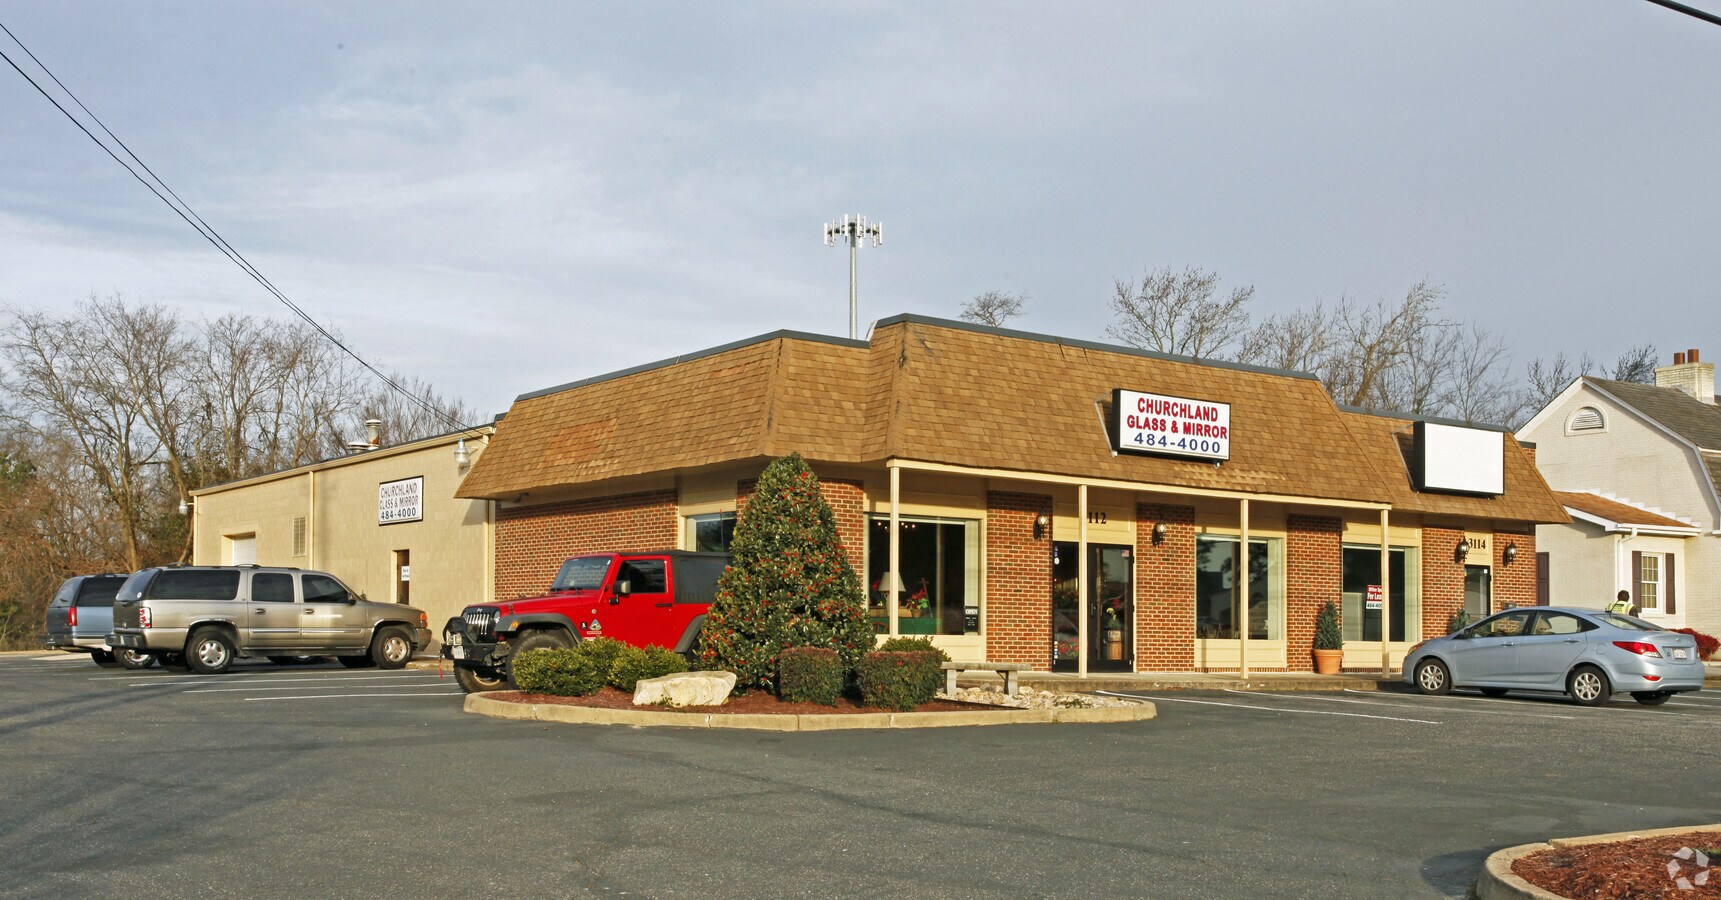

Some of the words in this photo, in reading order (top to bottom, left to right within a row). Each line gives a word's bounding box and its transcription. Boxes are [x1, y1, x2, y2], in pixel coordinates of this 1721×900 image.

[1137, 397, 1218, 422] CHURCHLAND
[1127, 414, 1166, 432] GLASS
[1170, 420, 1178, 433] &
[1183, 421, 1227, 439] MIRROR
[1134, 432, 1220, 453] 484-4000
[381, 482, 418, 499] CHURCHLAND
[380, 498, 393, 510] GLASS
[394, 497, 399, 508] &
[400, 495, 419, 507] MIRROR
[381, 507, 417, 520] 484-4000
[1468, 538, 1486, 549] 3114
